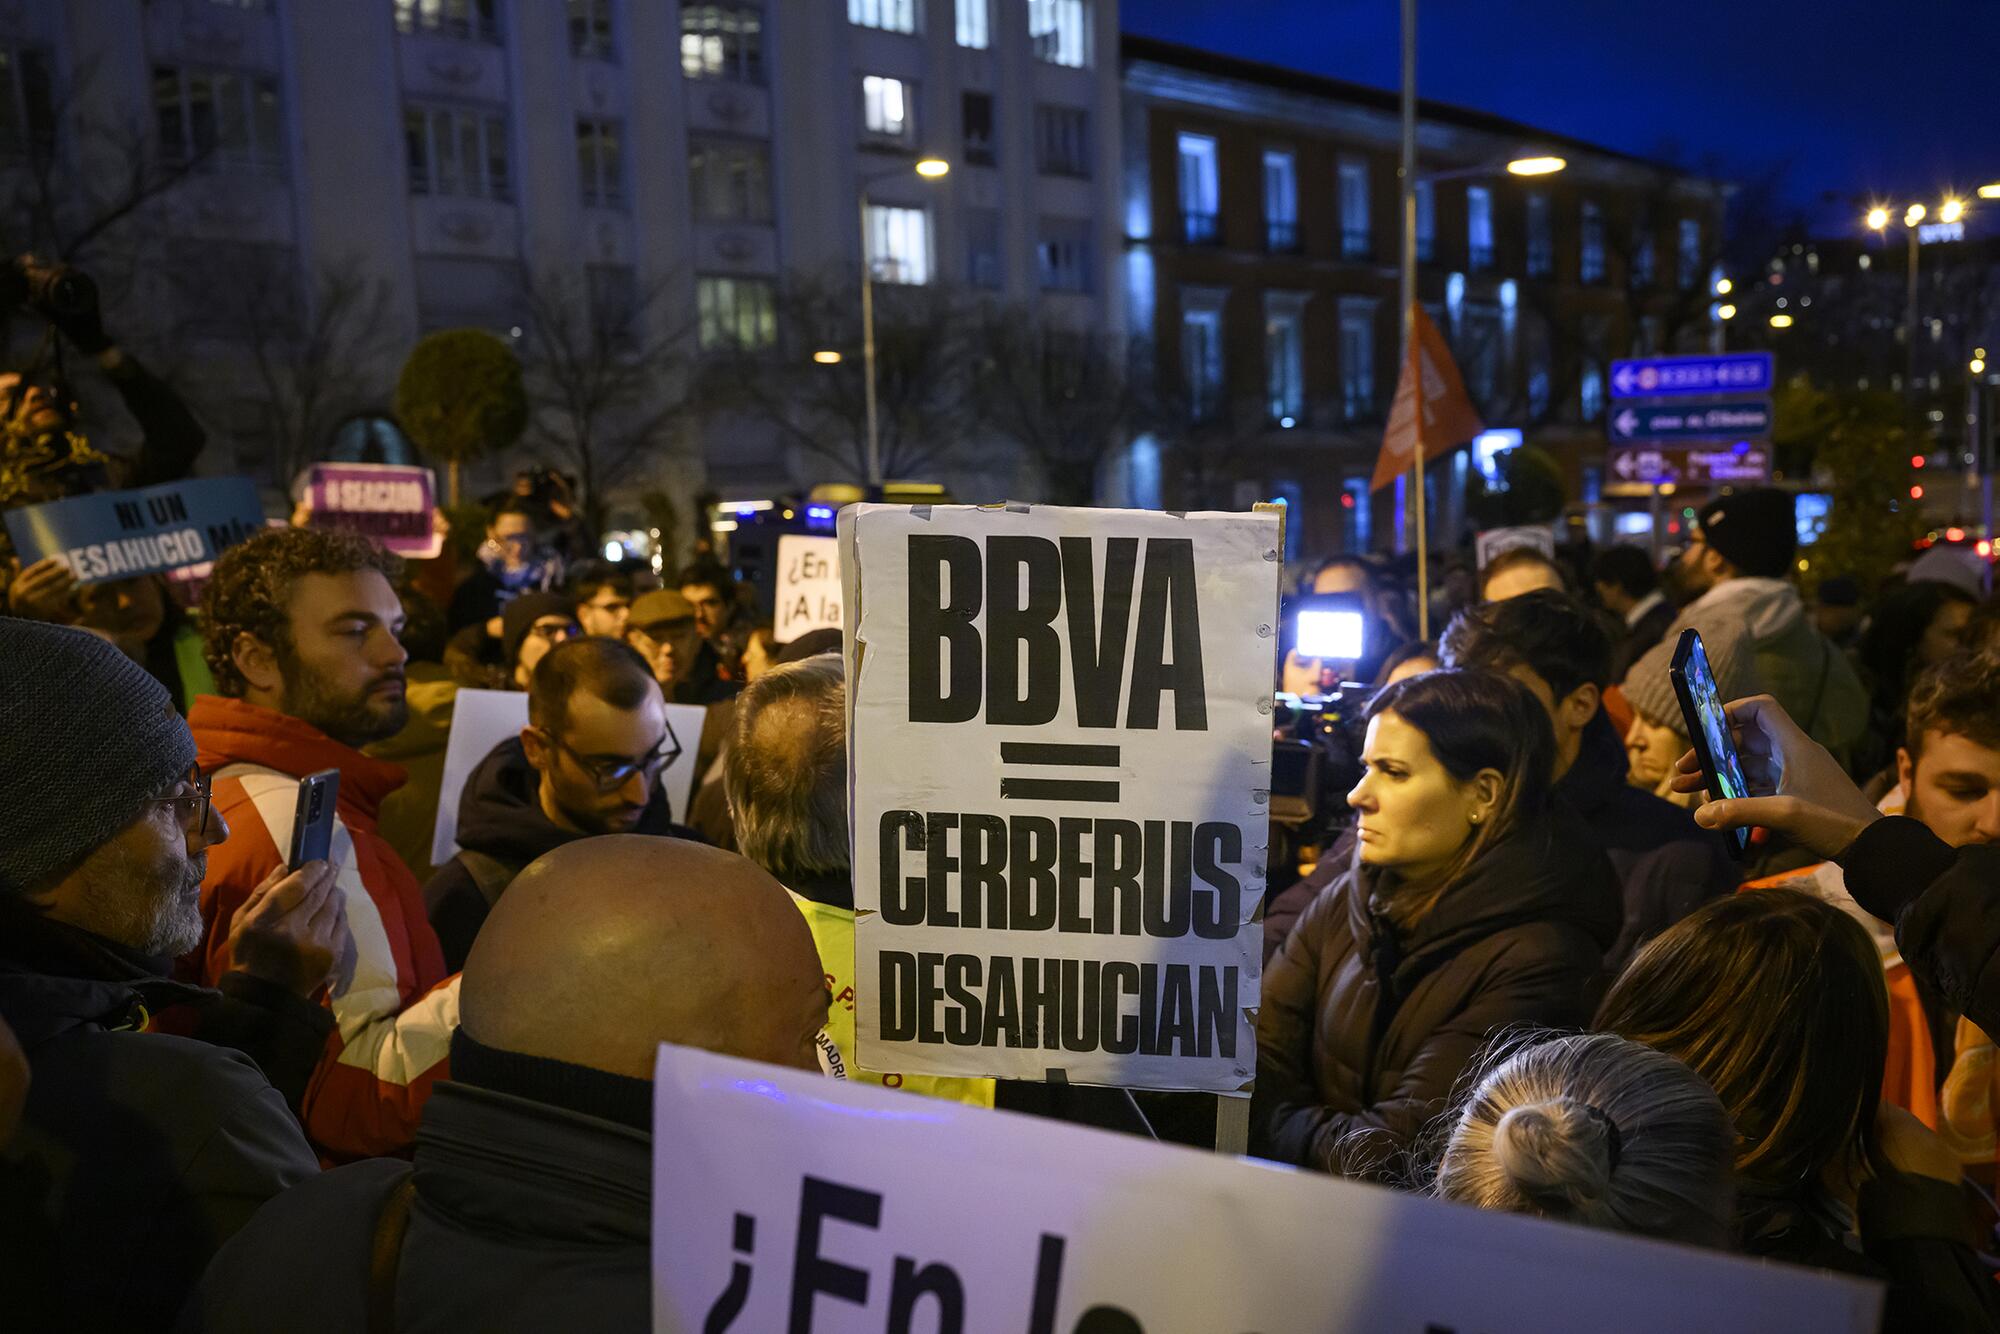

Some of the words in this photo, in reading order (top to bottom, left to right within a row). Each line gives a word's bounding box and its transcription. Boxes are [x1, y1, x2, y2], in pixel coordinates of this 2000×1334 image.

[113, 501, 145, 531] NI
[147, 492, 188, 526] UN
[206, 516, 256, 553] MÁ
[787, 551, 829, 585] ¿En
[783, 594, 811, 627] ¡A
[819, 595, 839, 624] la
[908, 534, 1208, 731] BBVA
[1000, 742, 1120, 803] =
[879, 810, 1242, 939] CERBERUS
[879, 951, 1238, 1059] DESAHUCIAN
[815, 1031, 848, 1081] MADRI
